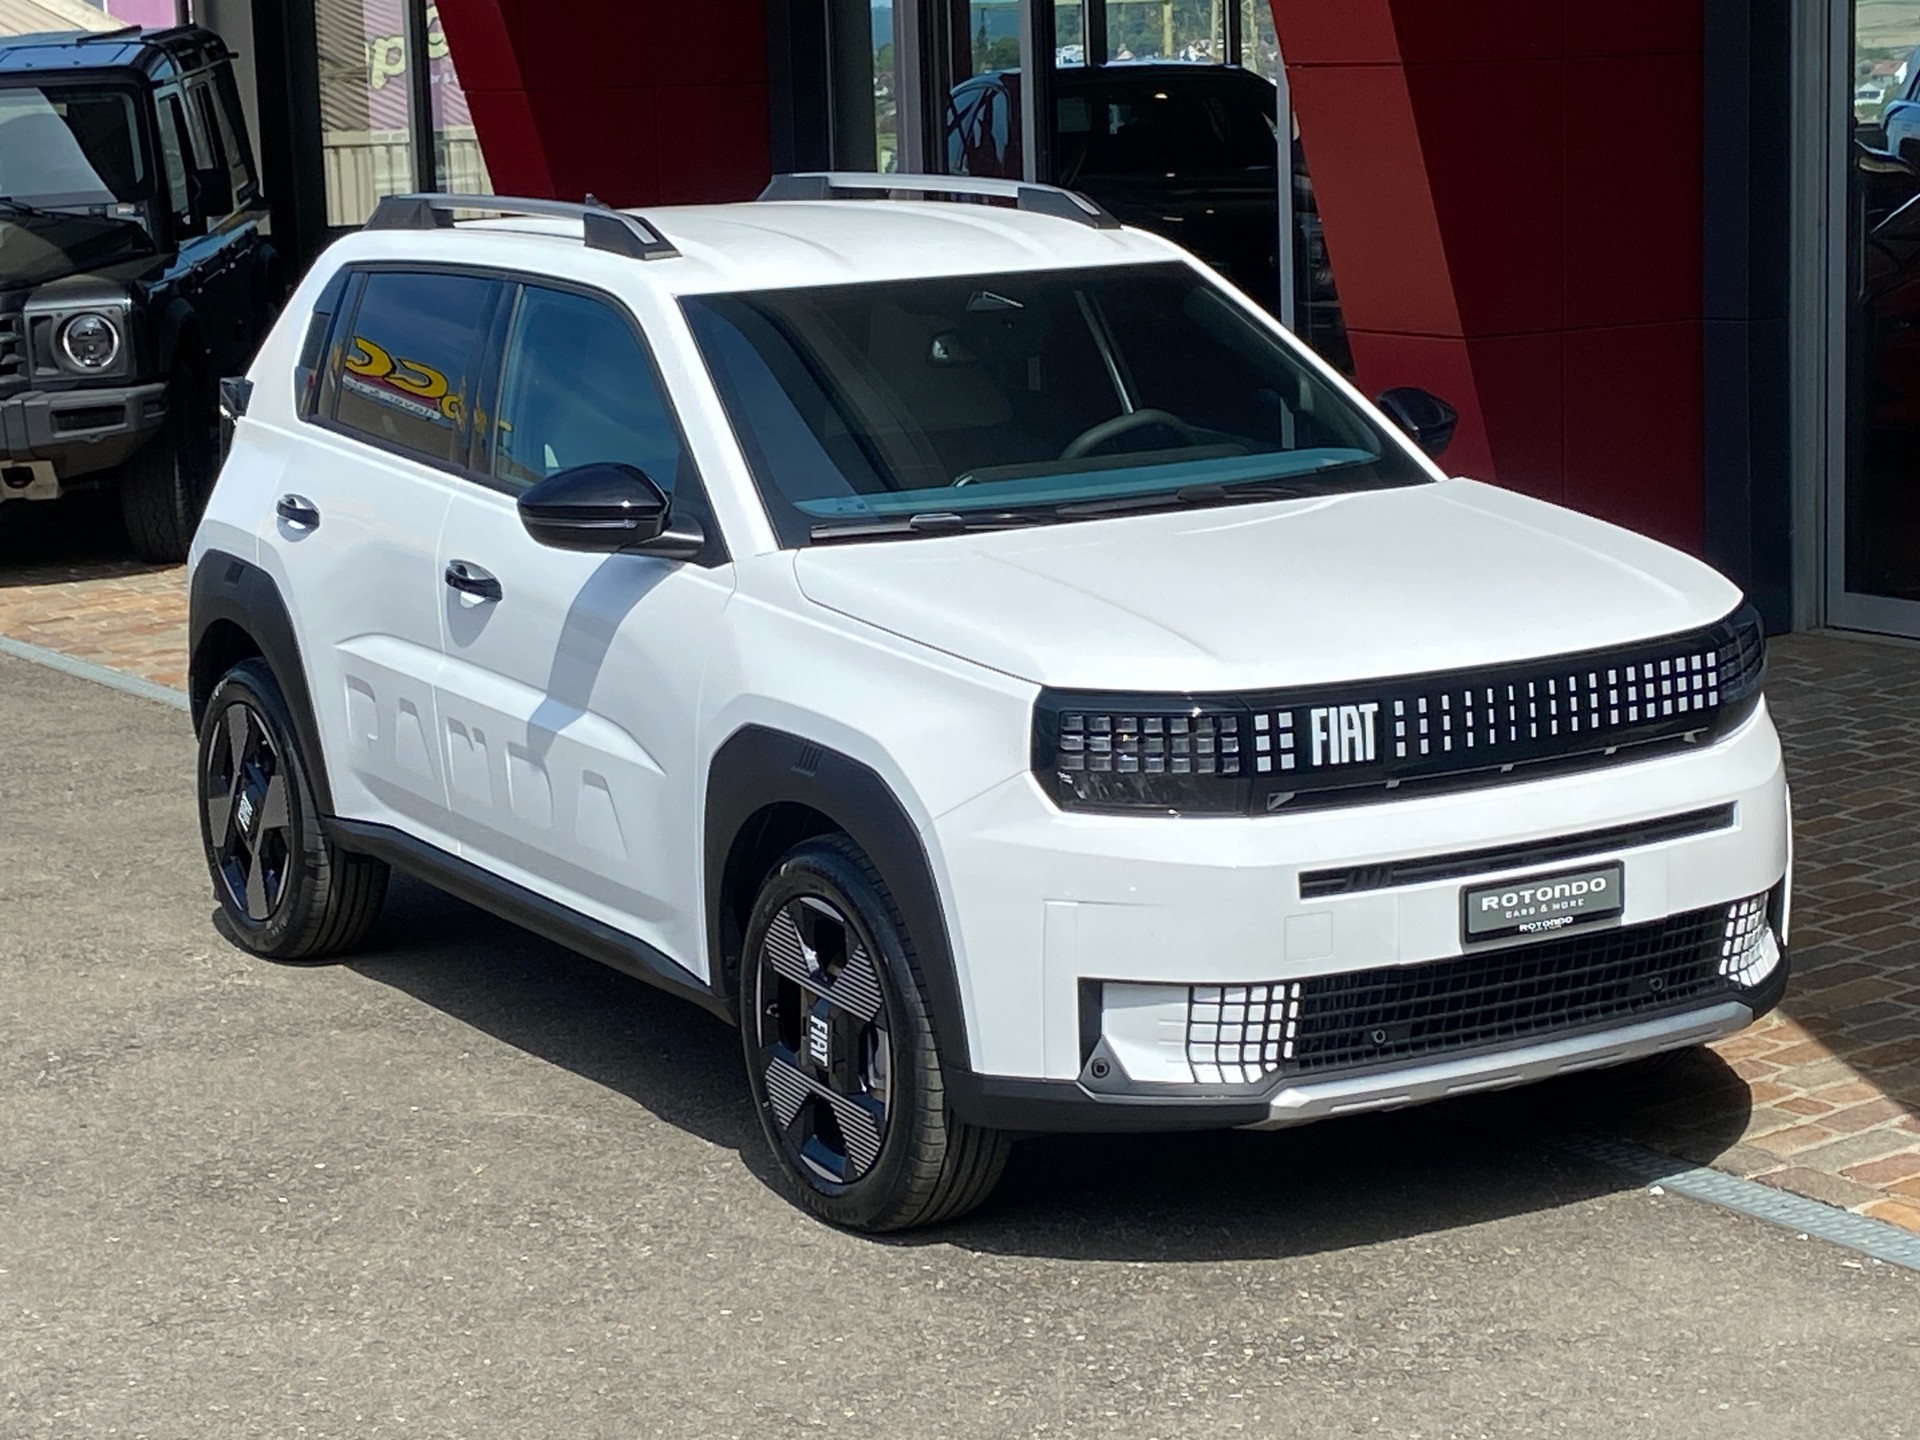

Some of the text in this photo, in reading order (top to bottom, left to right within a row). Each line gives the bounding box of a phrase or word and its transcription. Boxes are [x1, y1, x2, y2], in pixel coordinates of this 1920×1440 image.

[1310, 702, 1379, 766] FIAT
[1481, 877, 1607, 911] ROTONDO
[1540, 903, 1549, 913] &
[810, 1015, 828, 1067] FIAT
